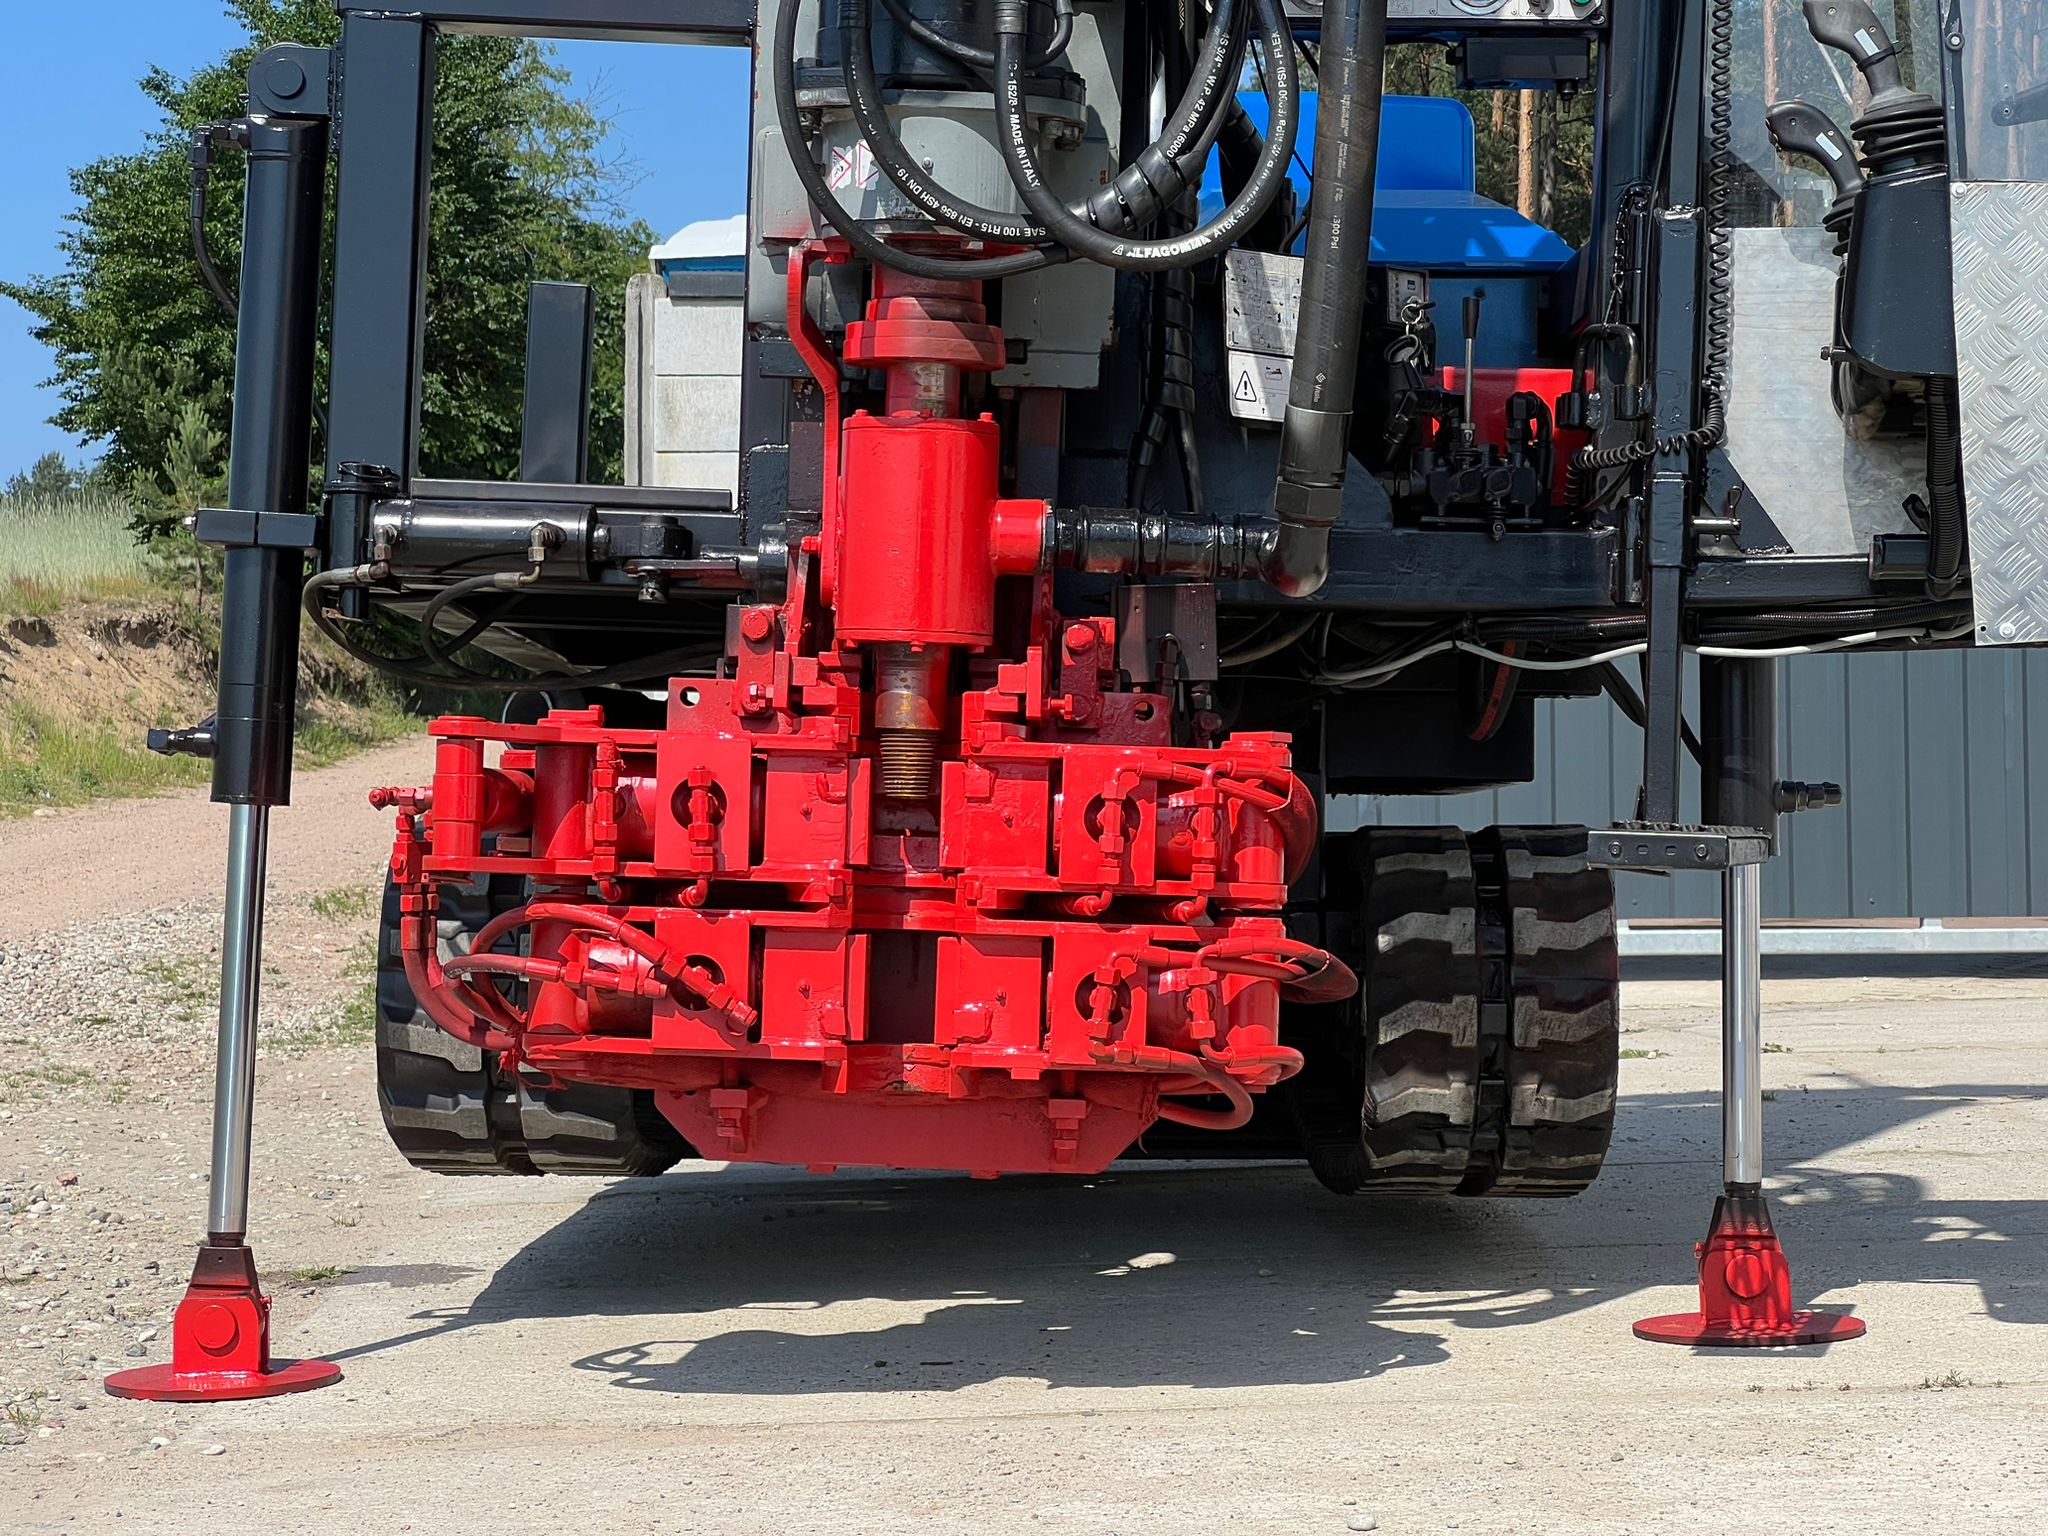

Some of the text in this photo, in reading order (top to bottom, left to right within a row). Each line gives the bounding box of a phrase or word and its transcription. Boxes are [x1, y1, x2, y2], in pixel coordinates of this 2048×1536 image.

[1007, 80, 1018, 106] 152/8
[1194, 98, 1206, 112] 42
[1182, 111, 1200, 133] MPa
[1010, 114, 1024, 146] MADE
[1016, 146, 1028, 159] IN
[897, 168, 909, 182] 19
[1020, 159, 1041, 188] ITALY
[906, 179, 923, 196] DN
[919, 193, 940, 210] 4SH
[940, 205, 958, 220] 856
[957, 216, 974, 228] EN
[981, 223, 1001, 235] R15
[1003, 226, 1021, 237] 100
[1024, 227, 1047, 237] SAE
